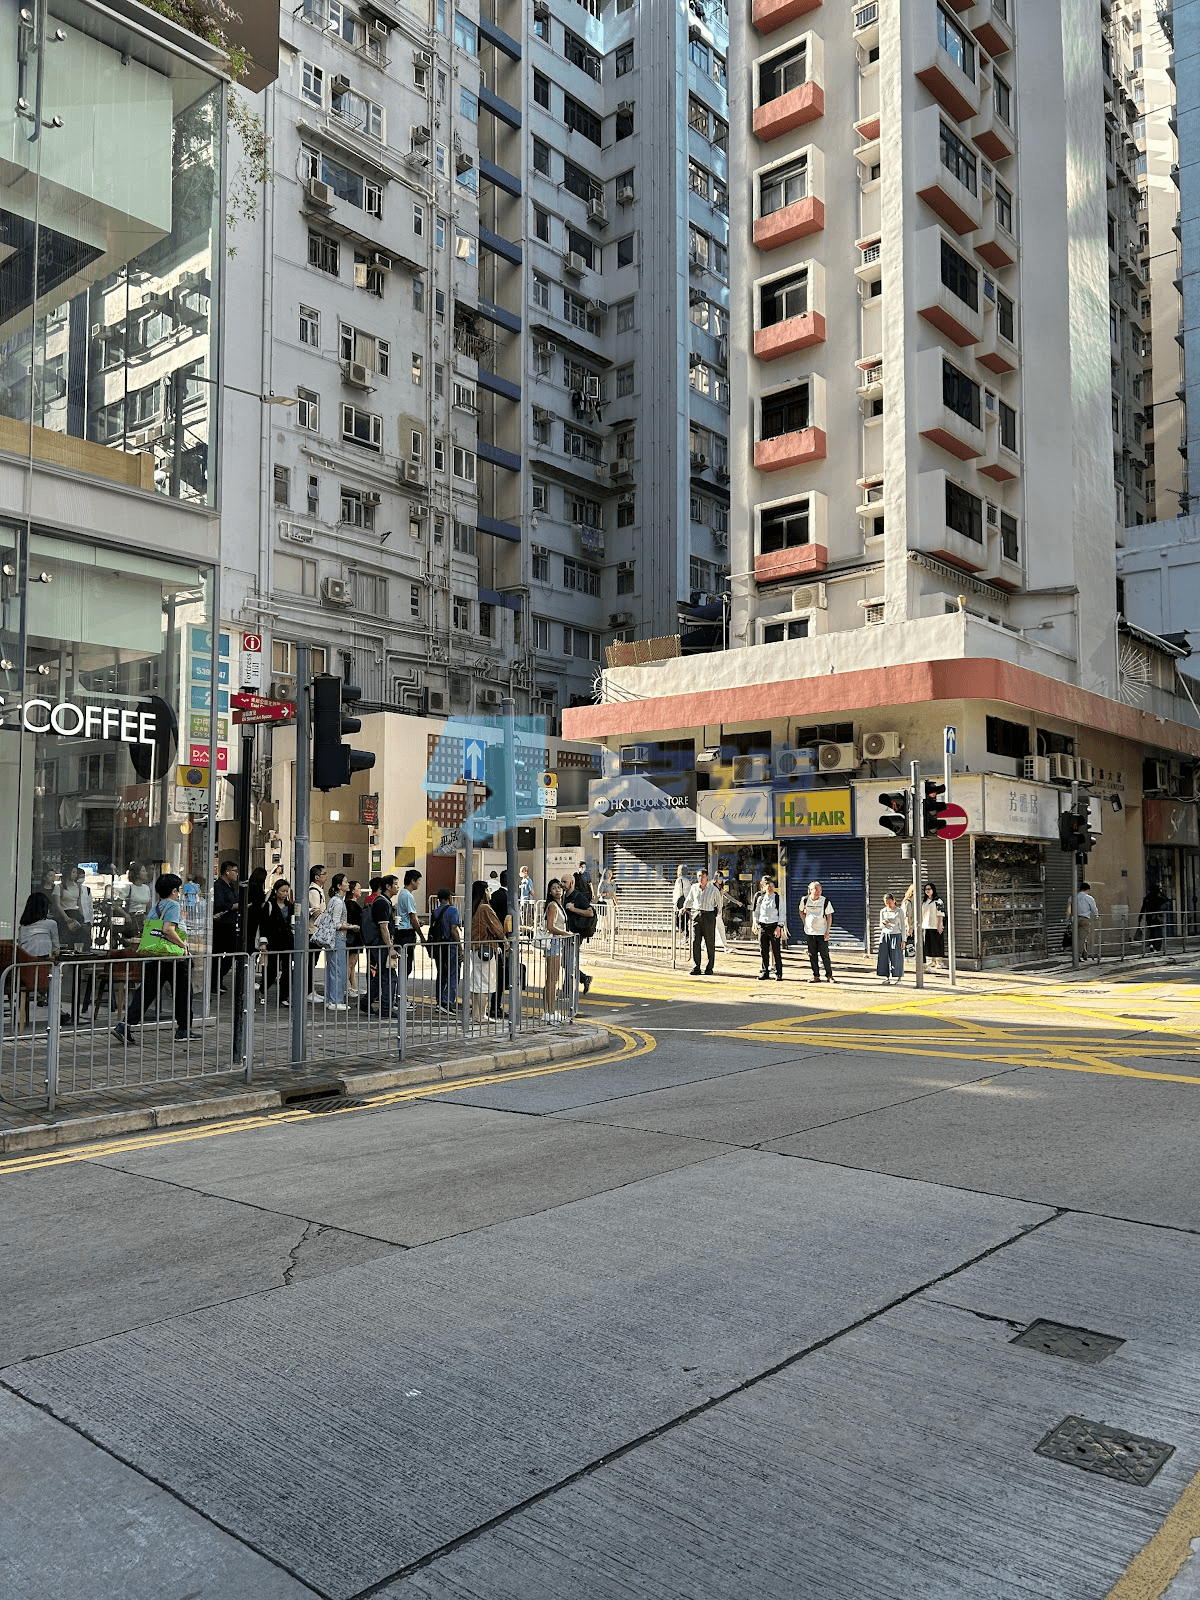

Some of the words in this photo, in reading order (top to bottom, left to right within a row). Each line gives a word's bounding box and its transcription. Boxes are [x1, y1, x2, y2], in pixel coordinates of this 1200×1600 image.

[244, 653, 252, 684] Fortress
[252, 662, 260, 677] Hill
[23, 699, 156, 745] COFFEE
[192, 749, 226, 760] DAO
[198, 789, 205, 798] 7
[198, 803, 209, 812] 12
[610, 799, 626, 810] HK
[627, 797, 660, 809] LIQUOR
[661, 795, 689, 807] STORE
[710, 804, 758, 823] Beauty
[807, 810, 846, 826] HAIR
